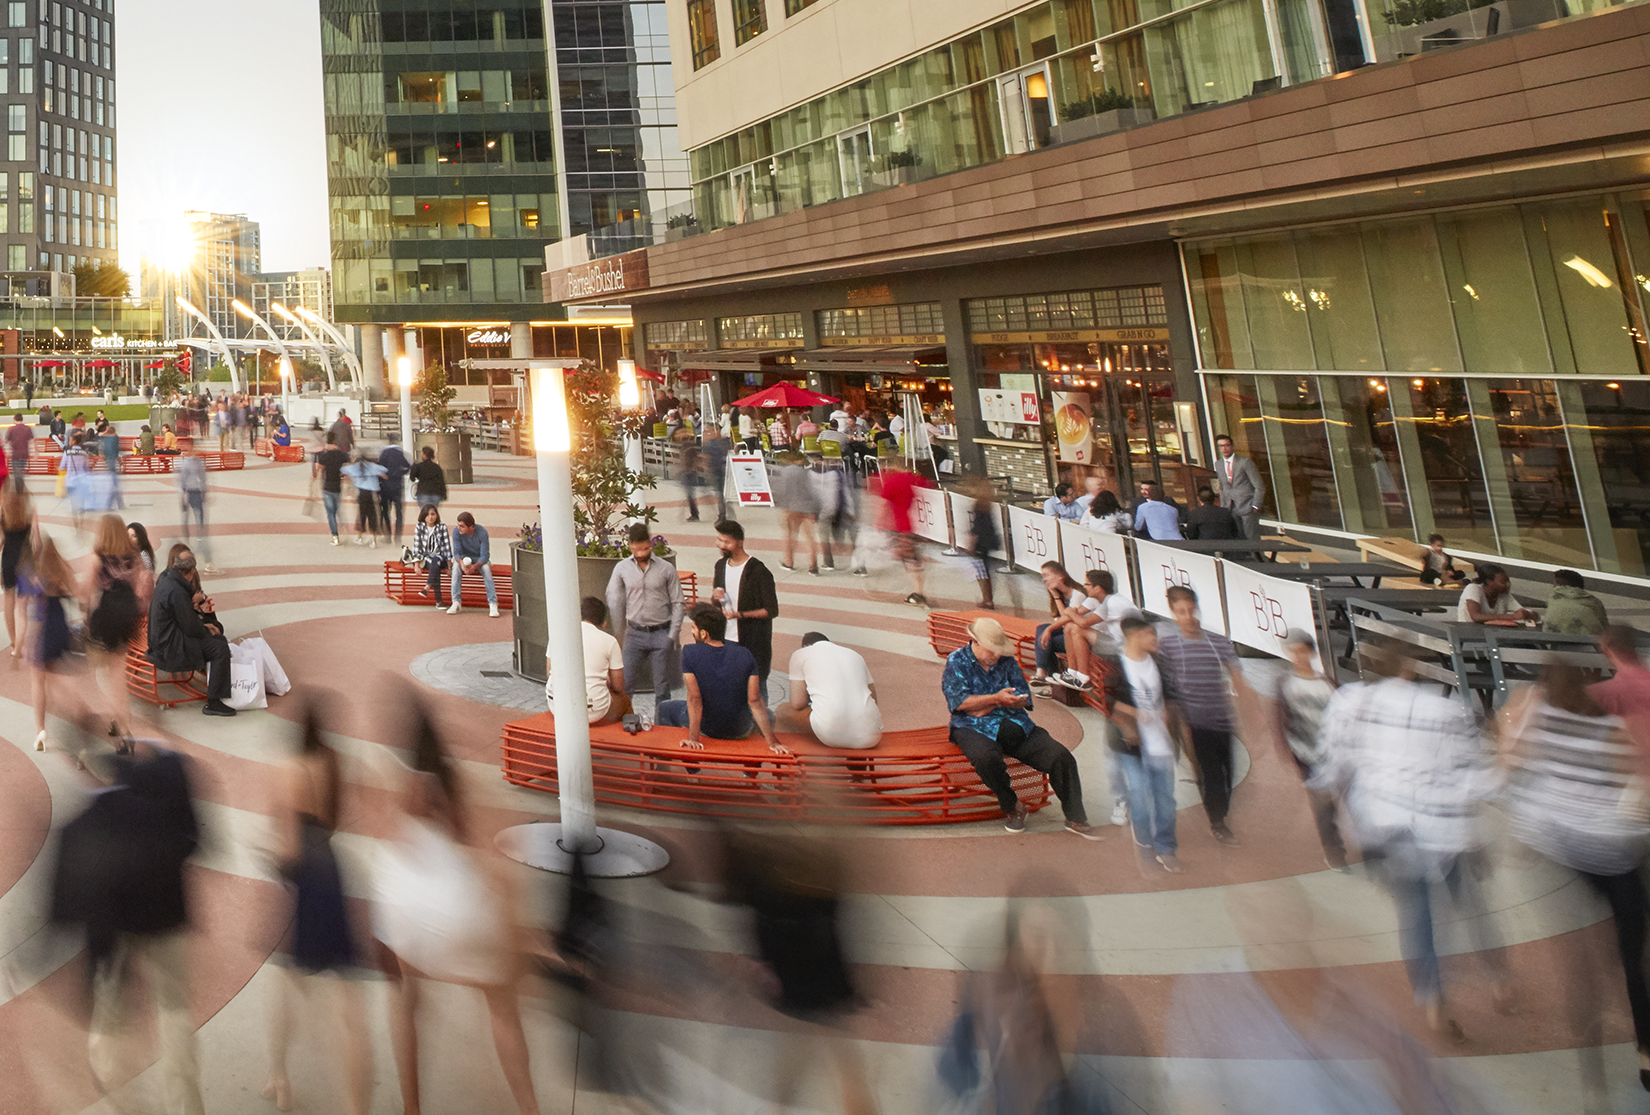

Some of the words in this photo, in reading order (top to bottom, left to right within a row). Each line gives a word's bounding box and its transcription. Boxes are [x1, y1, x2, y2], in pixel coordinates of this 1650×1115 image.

[91, 332, 125, 348] earls
[126, 340, 157, 348] KITCHEN
[163, 340, 178, 348] BAR
[467, 330, 503, 344] Eddie
[1047, 332, 1079, 341] BREAKFAST
[1117, 330, 1136, 339] GRAB
[1137, 330, 1143, 339] N
[1143, 329, 1155, 339] GO
[1023, 397, 1036, 420] illy
